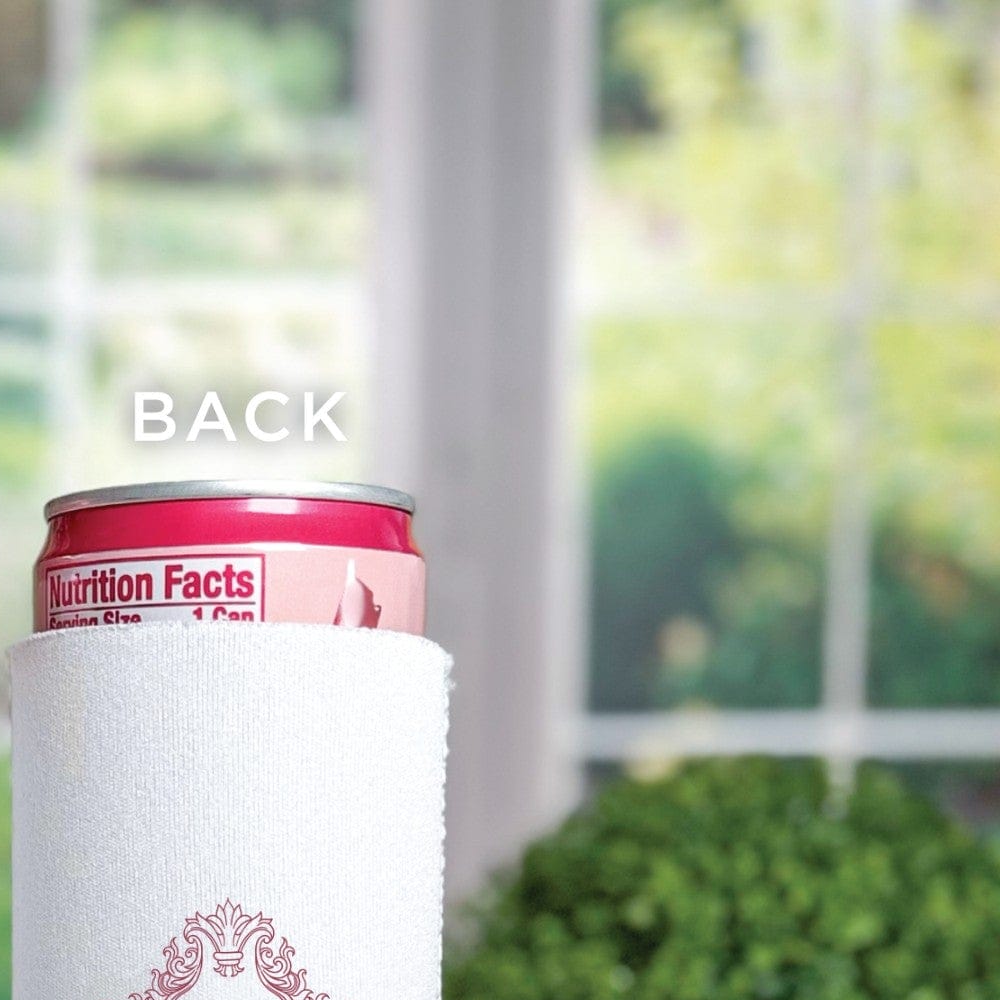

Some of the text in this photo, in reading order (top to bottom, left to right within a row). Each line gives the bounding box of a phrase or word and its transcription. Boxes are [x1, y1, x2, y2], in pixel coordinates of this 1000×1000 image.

[50, 564, 254, 610] Nutrition Facts
[192, 606, 203, 621] 1
[212, 606, 254, 622] Can
